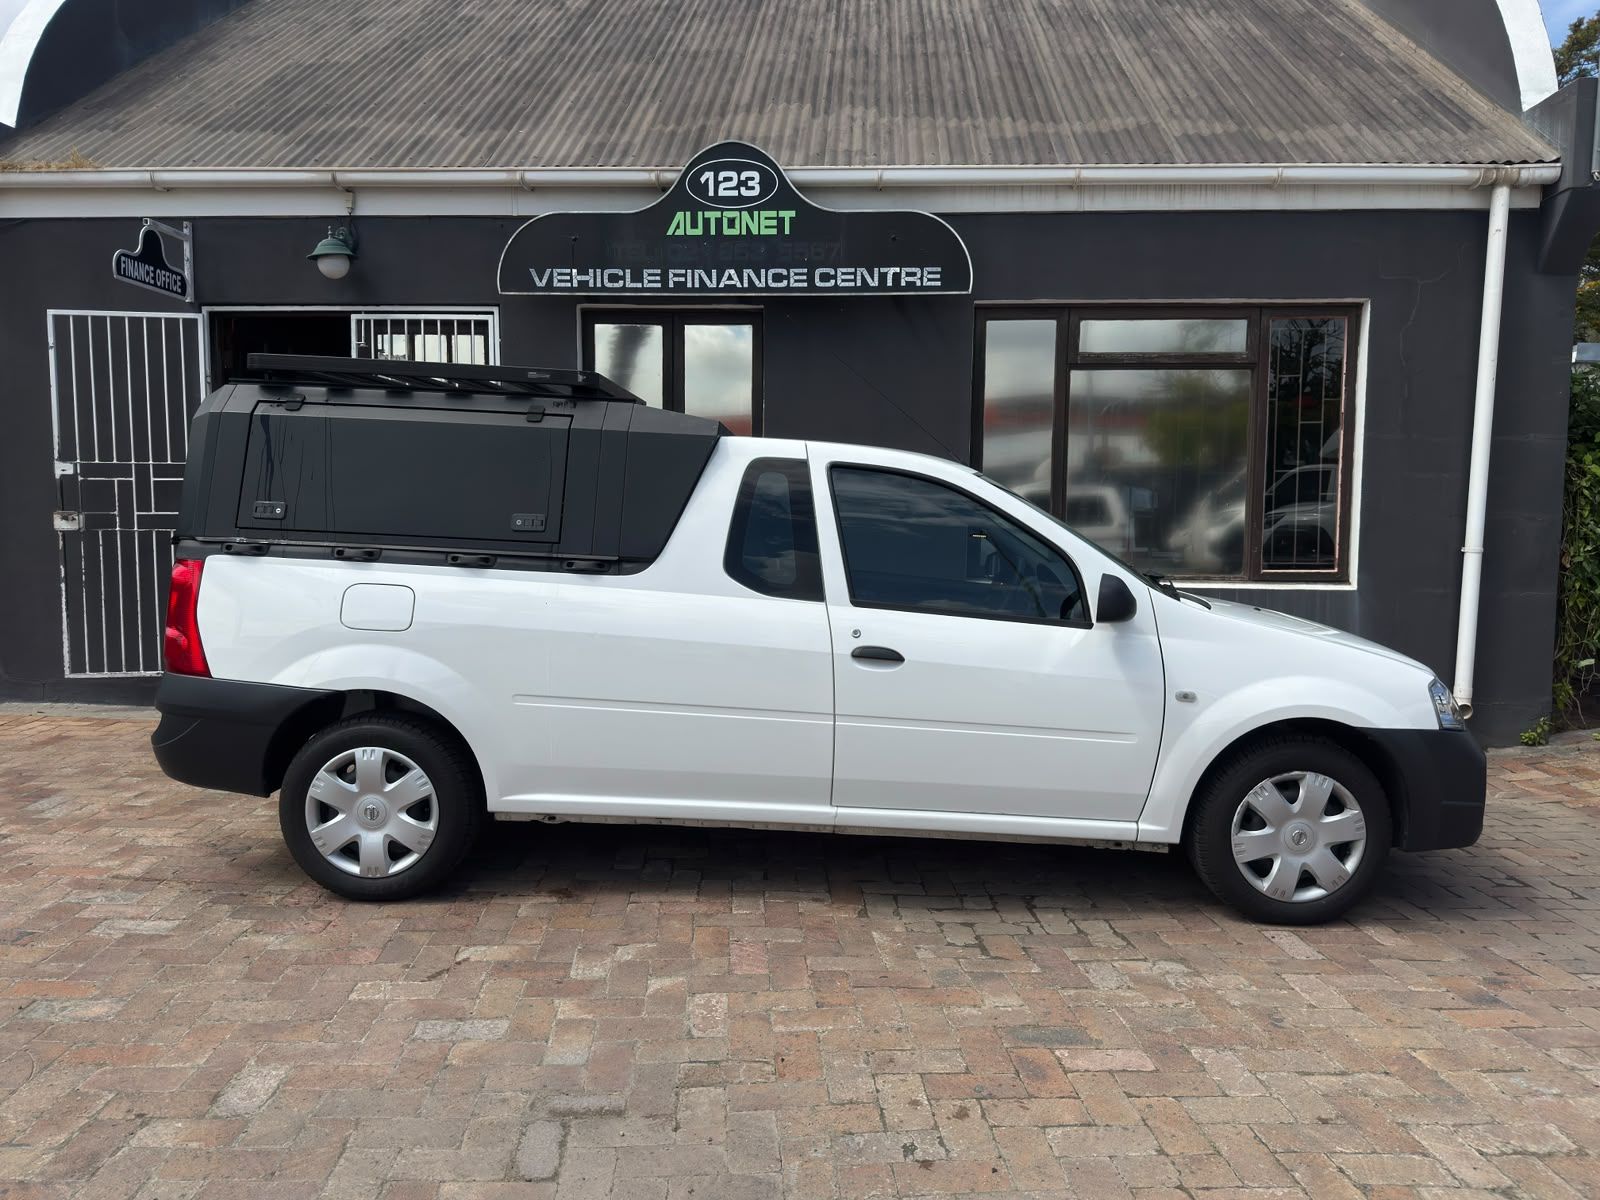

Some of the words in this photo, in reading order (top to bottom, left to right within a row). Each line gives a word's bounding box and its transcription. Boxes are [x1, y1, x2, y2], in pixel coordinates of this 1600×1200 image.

[700, 170, 760, 197] 123
[666, 210, 796, 236] AUTONET
[120, 256, 155, 285] FINANCE
[155, 269, 182, 293] OFFICE
[529, 268, 662, 288] VEHICLE
[668, 268, 808, 288] FINANCE
[814, 267, 942, 287] CENTRE
